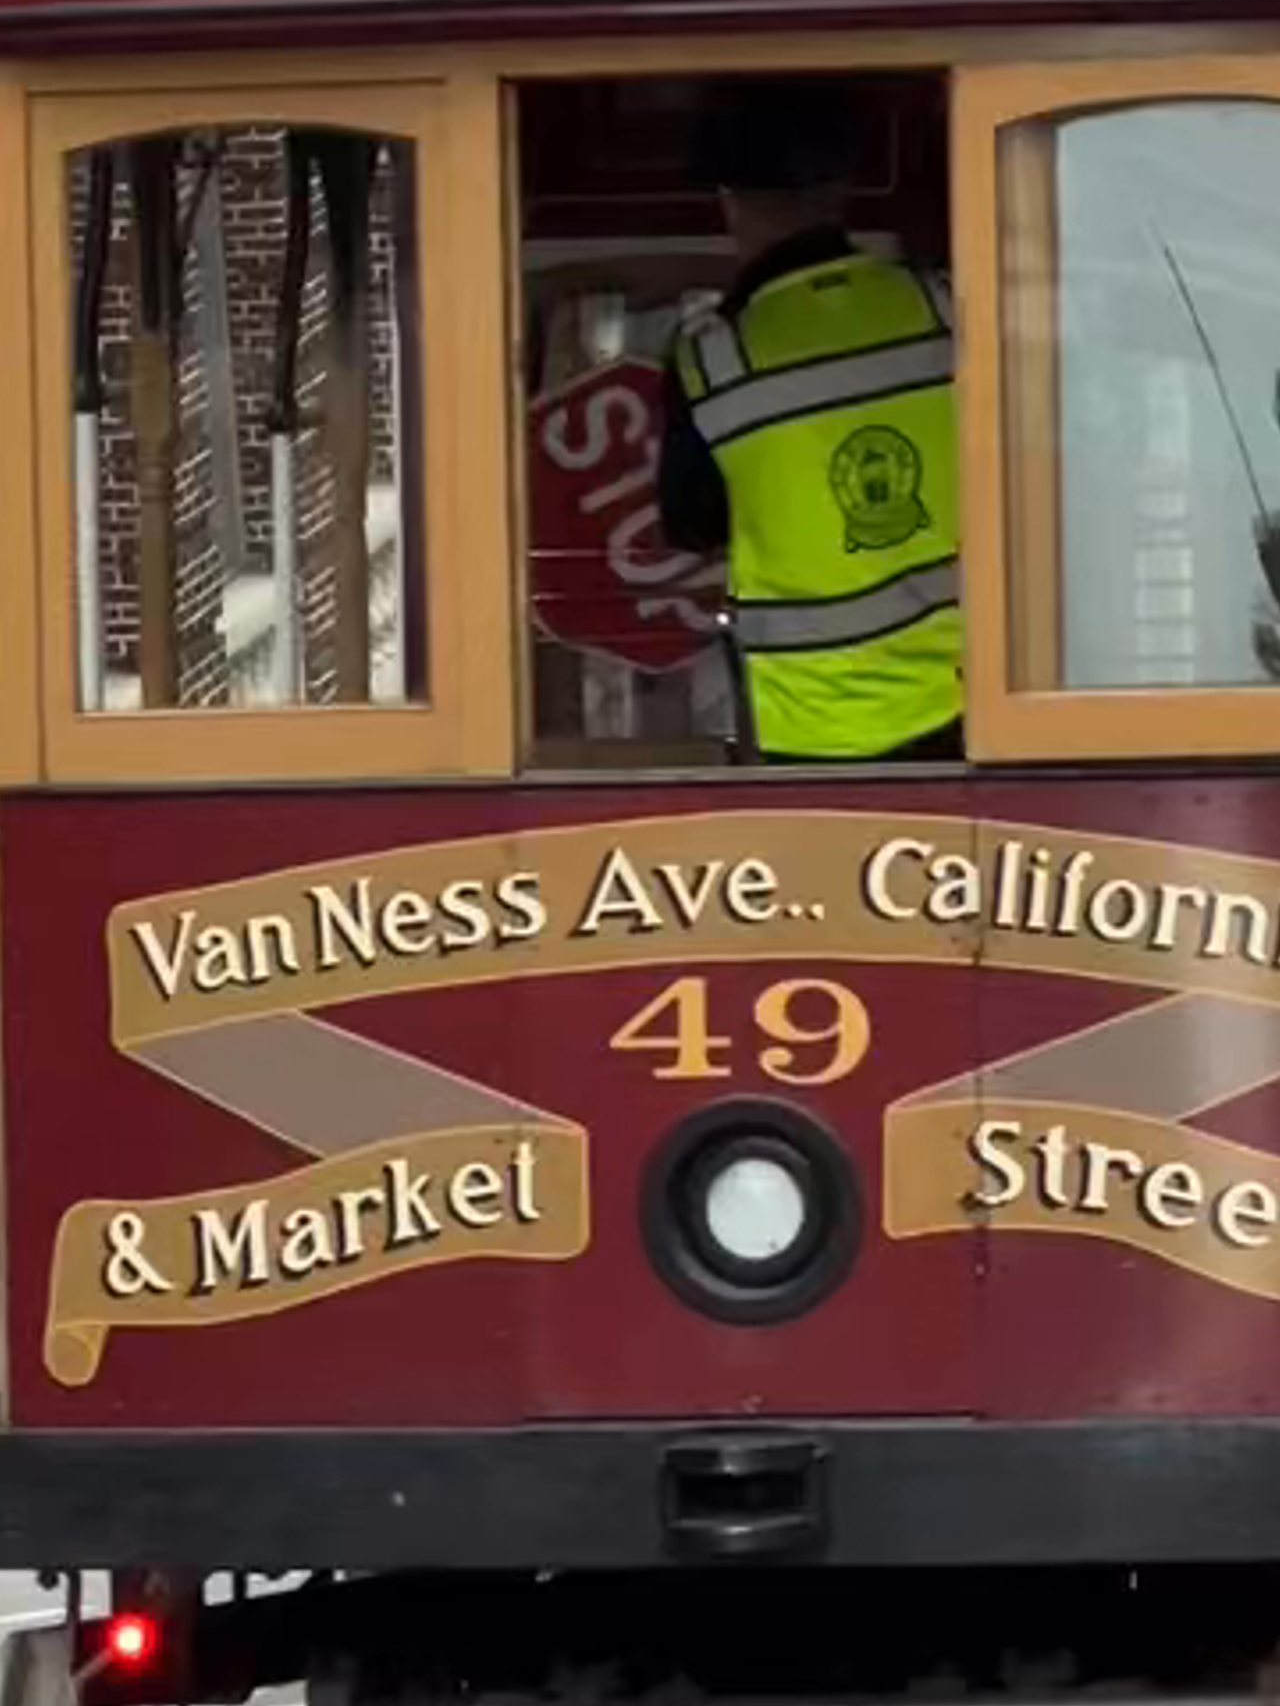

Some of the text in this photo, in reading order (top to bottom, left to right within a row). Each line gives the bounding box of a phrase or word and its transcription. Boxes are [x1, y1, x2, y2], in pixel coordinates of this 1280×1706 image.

[541, 384, 718, 632] STO
[130, 910, 301, 1001] Van
[308, 874, 549, 969] Ness
[609, 974, 871, 1086] 49
[104, 1141, 543, 1298] & Market
